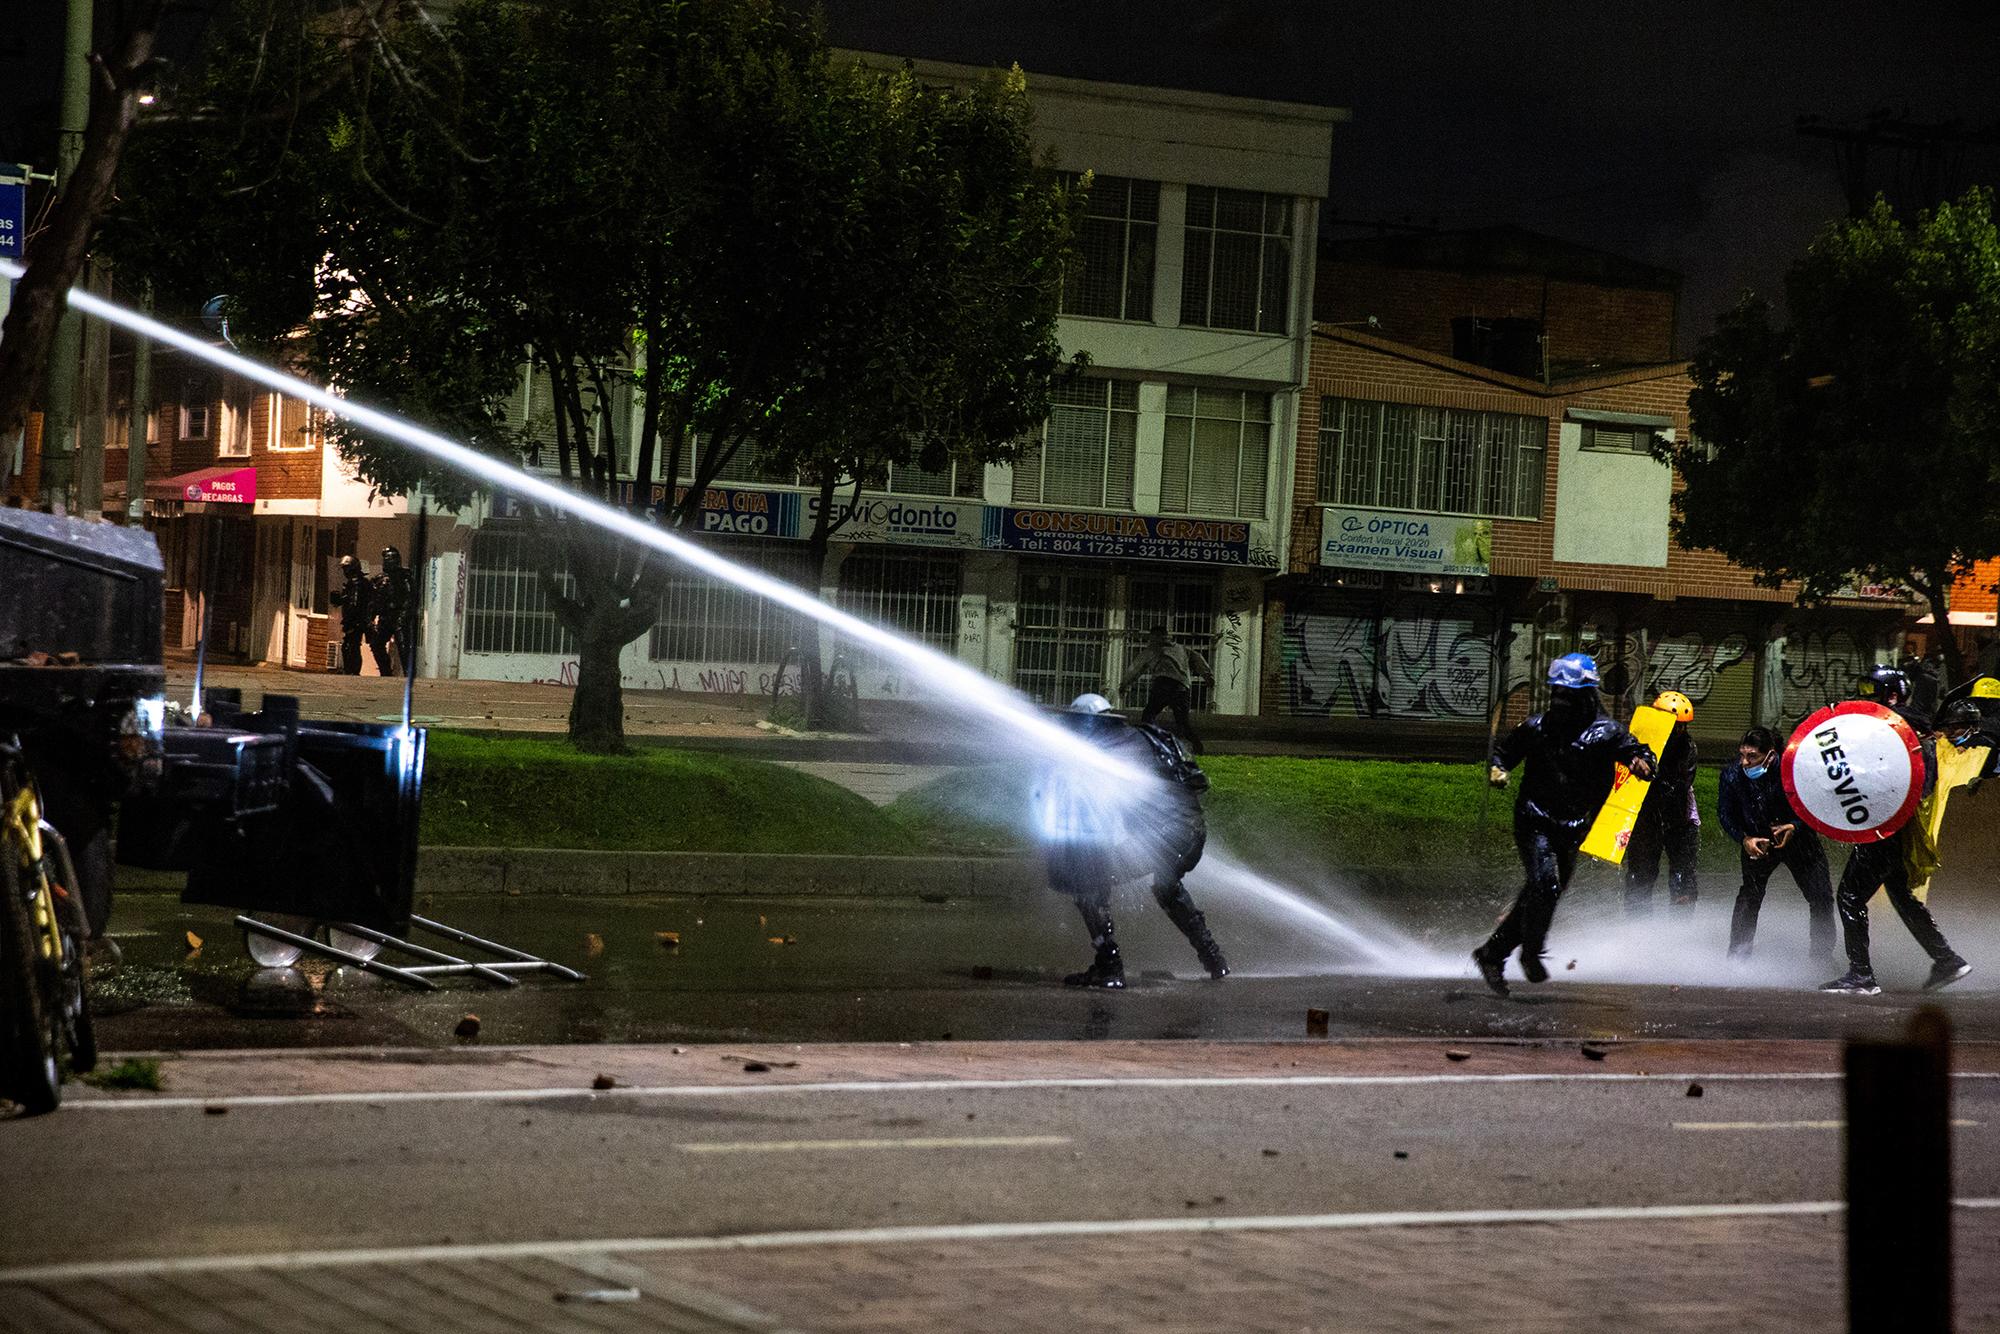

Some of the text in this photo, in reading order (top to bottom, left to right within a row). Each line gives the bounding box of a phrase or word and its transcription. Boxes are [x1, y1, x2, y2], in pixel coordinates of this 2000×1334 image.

[211, 481, 236, 491] PAGOS
[201, 493, 243, 503] RECARGAS
[733, 492, 769, 514] CITA
[704, 511, 769, 534] PAGO
[1014, 511, 1247, 543] CONSULTA GRATIS
[1367, 516, 1430, 536] ÓPTICA
[1020, 538, 1048, 550] Tel:
[1053, 540, 1081, 551] 804
[1087, 542, 1124, 554] 1725
[1034, 531, 1112, 542] ORTODONCIA
[1142, 538, 1180, 546] CUOTA
[1340, 533, 1372, 544] Confort
[1405, 538, 1430, 548] 20/20
[1325, 541, 1390, 556] Examen
[1395, 545, 1443, 559] Visual
[1814, 727, 1870, 825] DESVÍO
